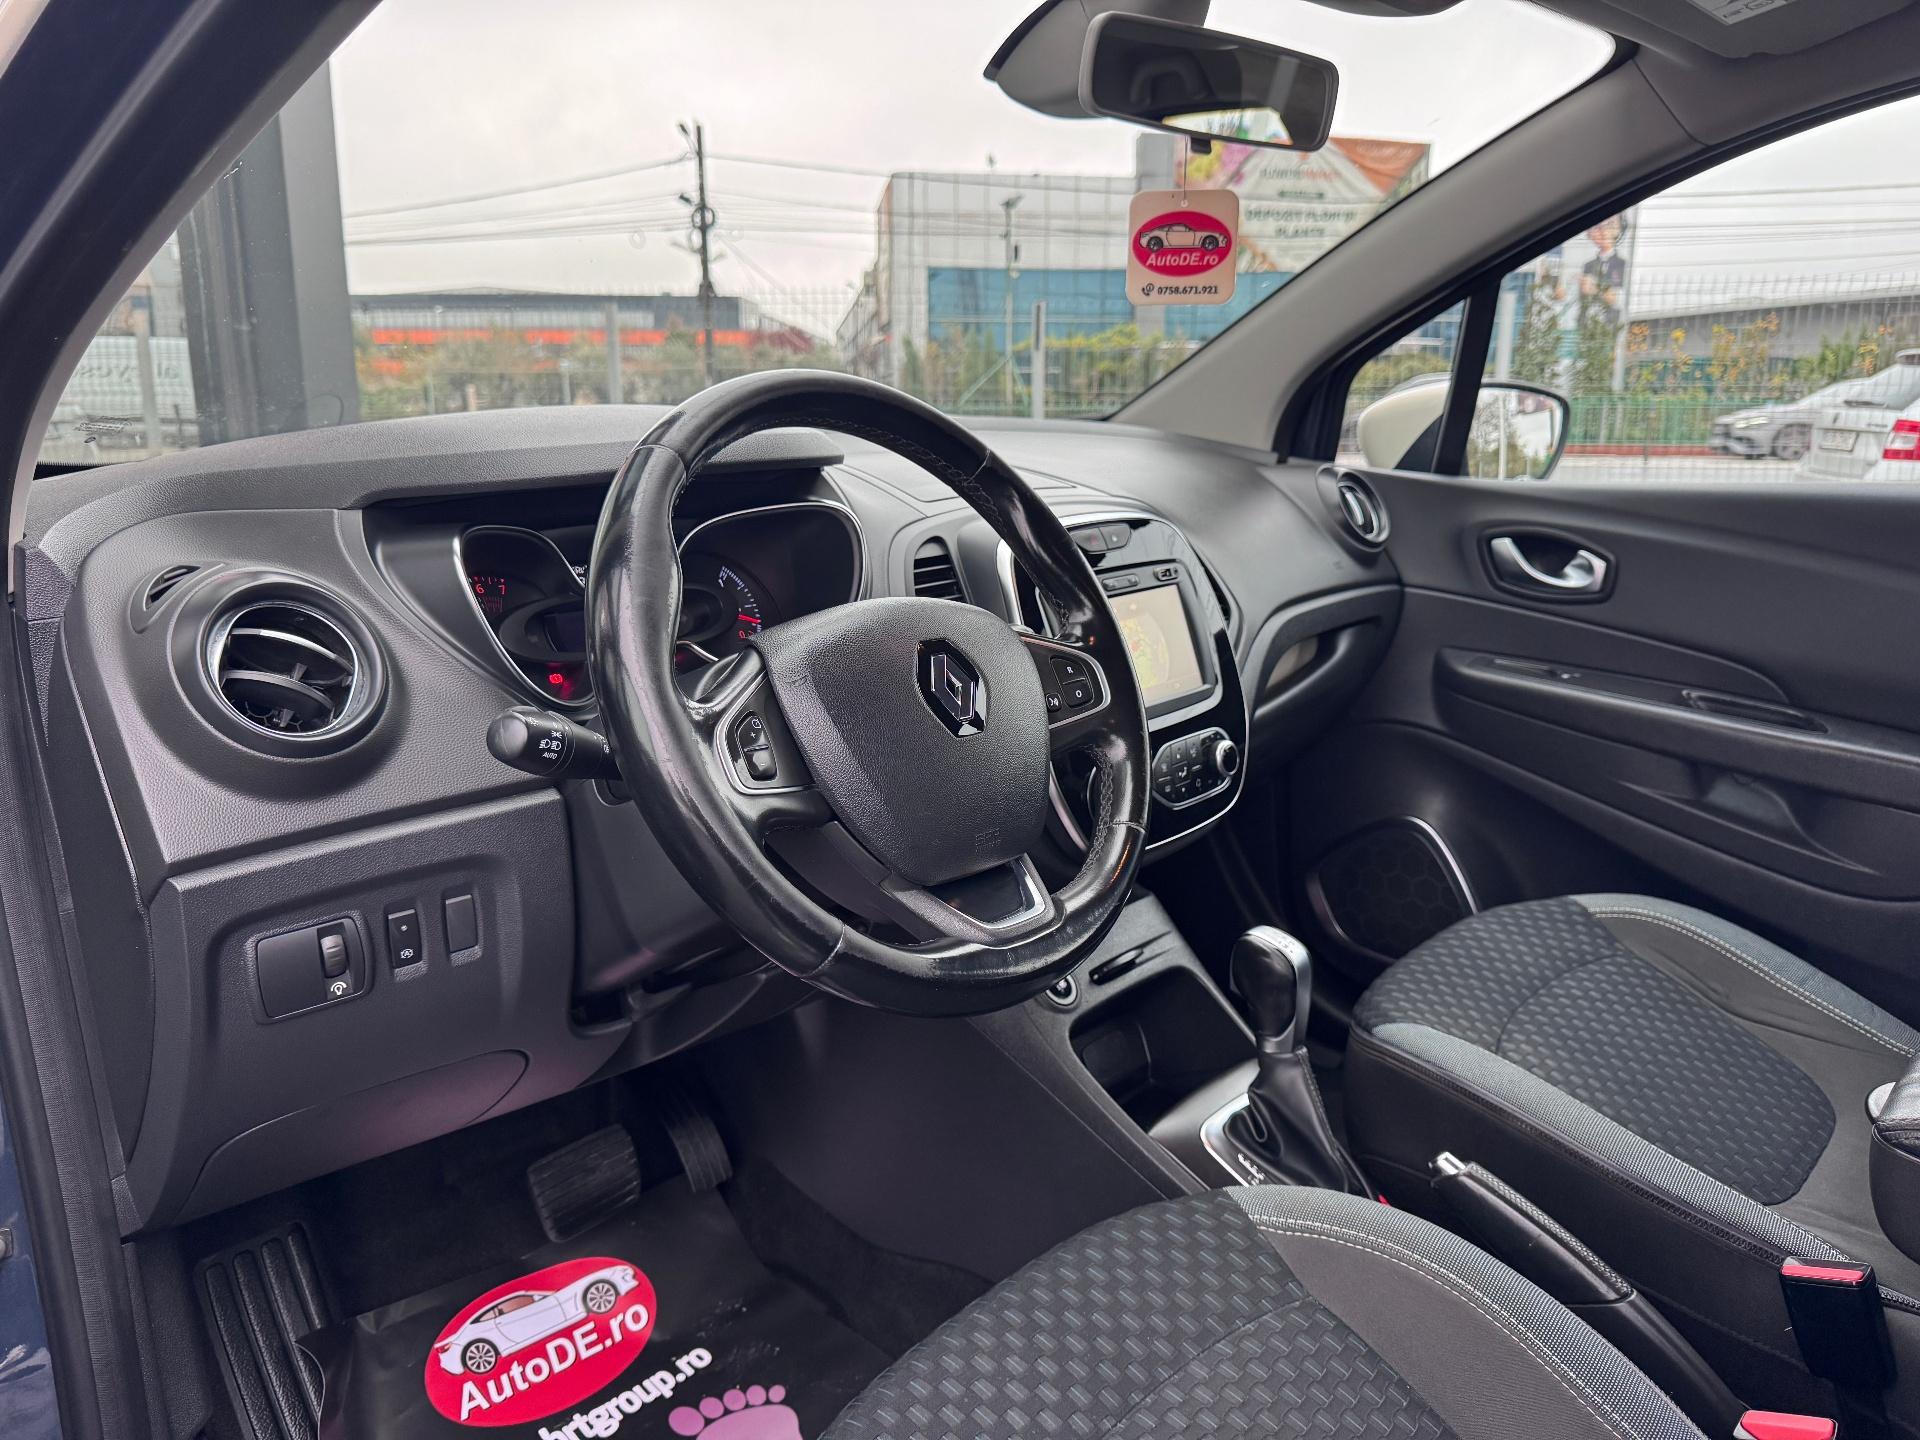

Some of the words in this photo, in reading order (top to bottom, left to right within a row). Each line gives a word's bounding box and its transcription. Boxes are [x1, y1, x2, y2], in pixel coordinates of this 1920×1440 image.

[1145, 252, 1219, 268] AutoDE.ro
[1157, 285, 1218, 296] 0758.671.921
[475, 583, 485, 594] 6
[497, 584, 506, 595] 7
[1066, 666, 1074, 674] R
[542, 750, 558, 760] AUTO
[460, 1303, 649, 1422] AutoDE.ro
